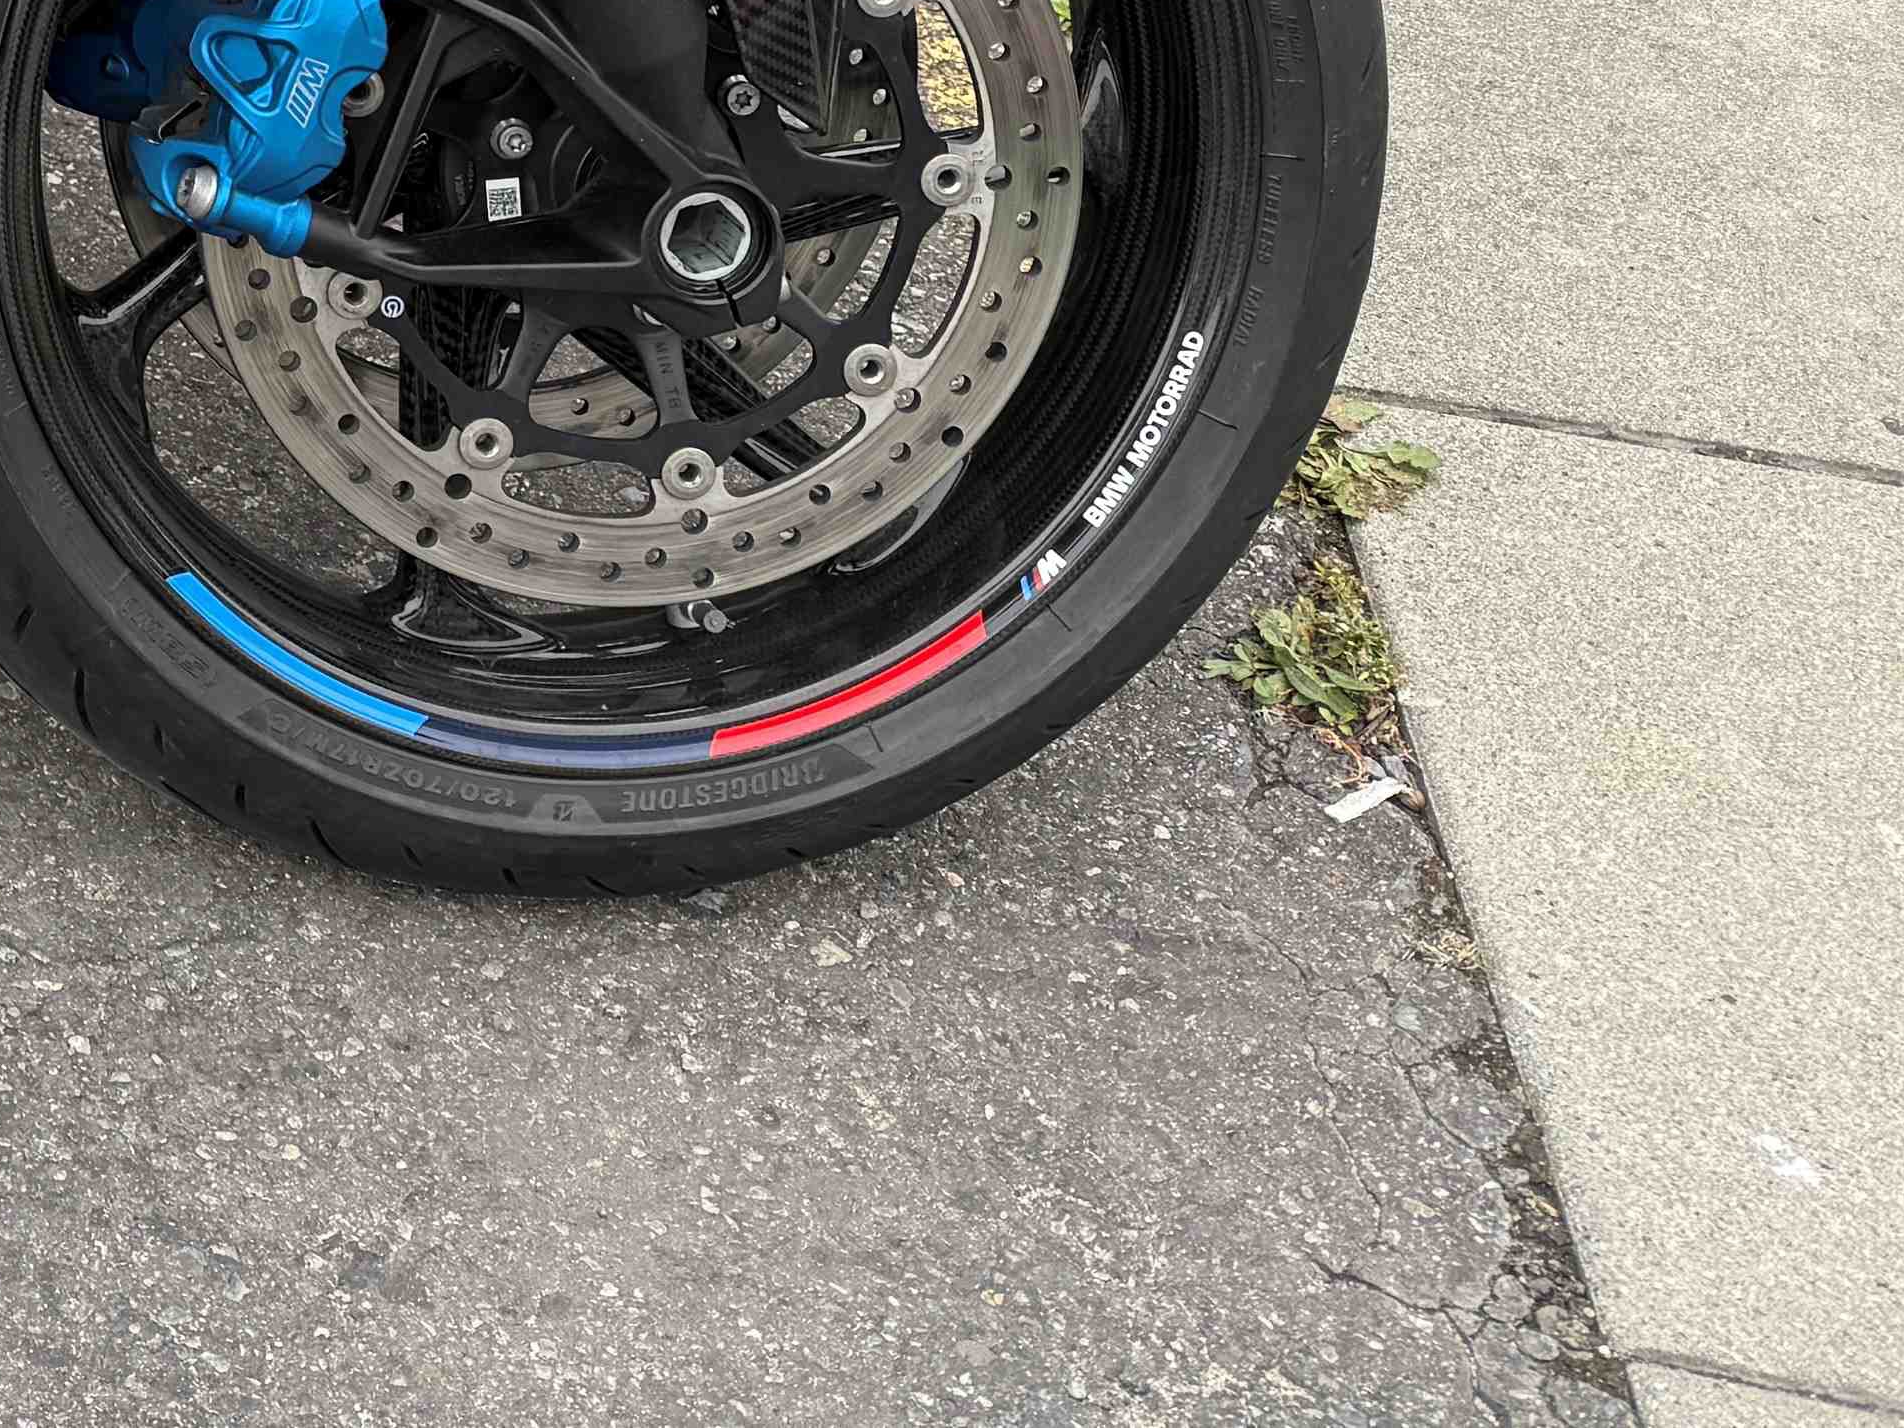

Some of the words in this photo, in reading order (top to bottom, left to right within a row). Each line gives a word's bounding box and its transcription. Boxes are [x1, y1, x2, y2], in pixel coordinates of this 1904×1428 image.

[1085, 468, 1138, 528] BMW
[1128, 328, 1206, 470] MOTORRAD
[620, 756, 828, 814] BRIDGESTONE
